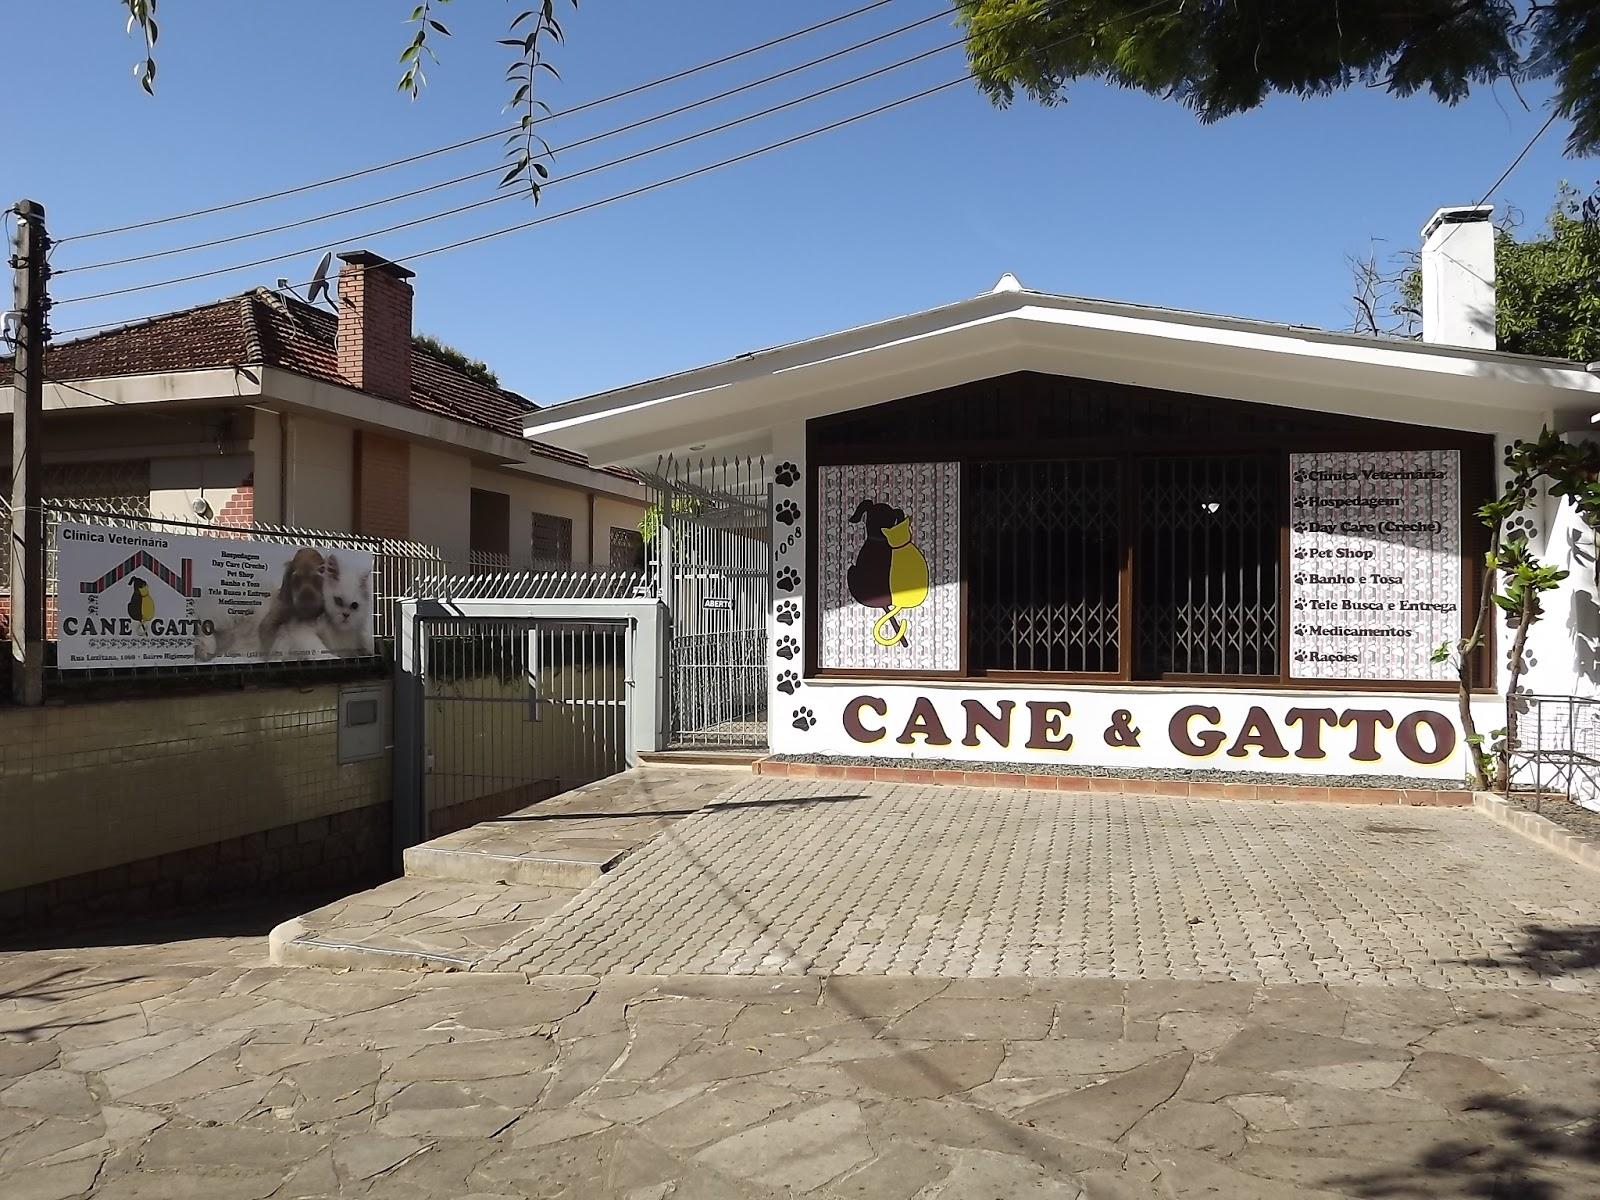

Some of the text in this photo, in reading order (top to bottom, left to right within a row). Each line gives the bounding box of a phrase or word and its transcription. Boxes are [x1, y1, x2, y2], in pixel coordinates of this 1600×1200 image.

[1362, 469, 1444, 480] Veterinária
[1309, 496, 1399, 508] Hospedagem
[1309, 521, 1441, 534] Day Care (Creche)
[62, 528, 168, 548] Clínica Veterinária
[774, 526, 802, 561] 1068
[1309, 548, 1373, 560] Pet Shop
[211, 560, 224, 568] Day
[225, 561, 240, 569] Care
[238, 571, 254, 579] Shop
[1309, 574, 1355, 584] Banho
[1370, 574, 1403, 584] Tosa
[208, 588, 222, 596] Tele
[1309, 599, 1457, 614] Tele Busca e Entrega
[62, 617, 215, 636] CANE GATTO
[1309, 626, 1412, 637] Medicamentos
[1309, 651, 1358, 664] Rações
[842, 695, 1457, 766] CANE & GATTO
